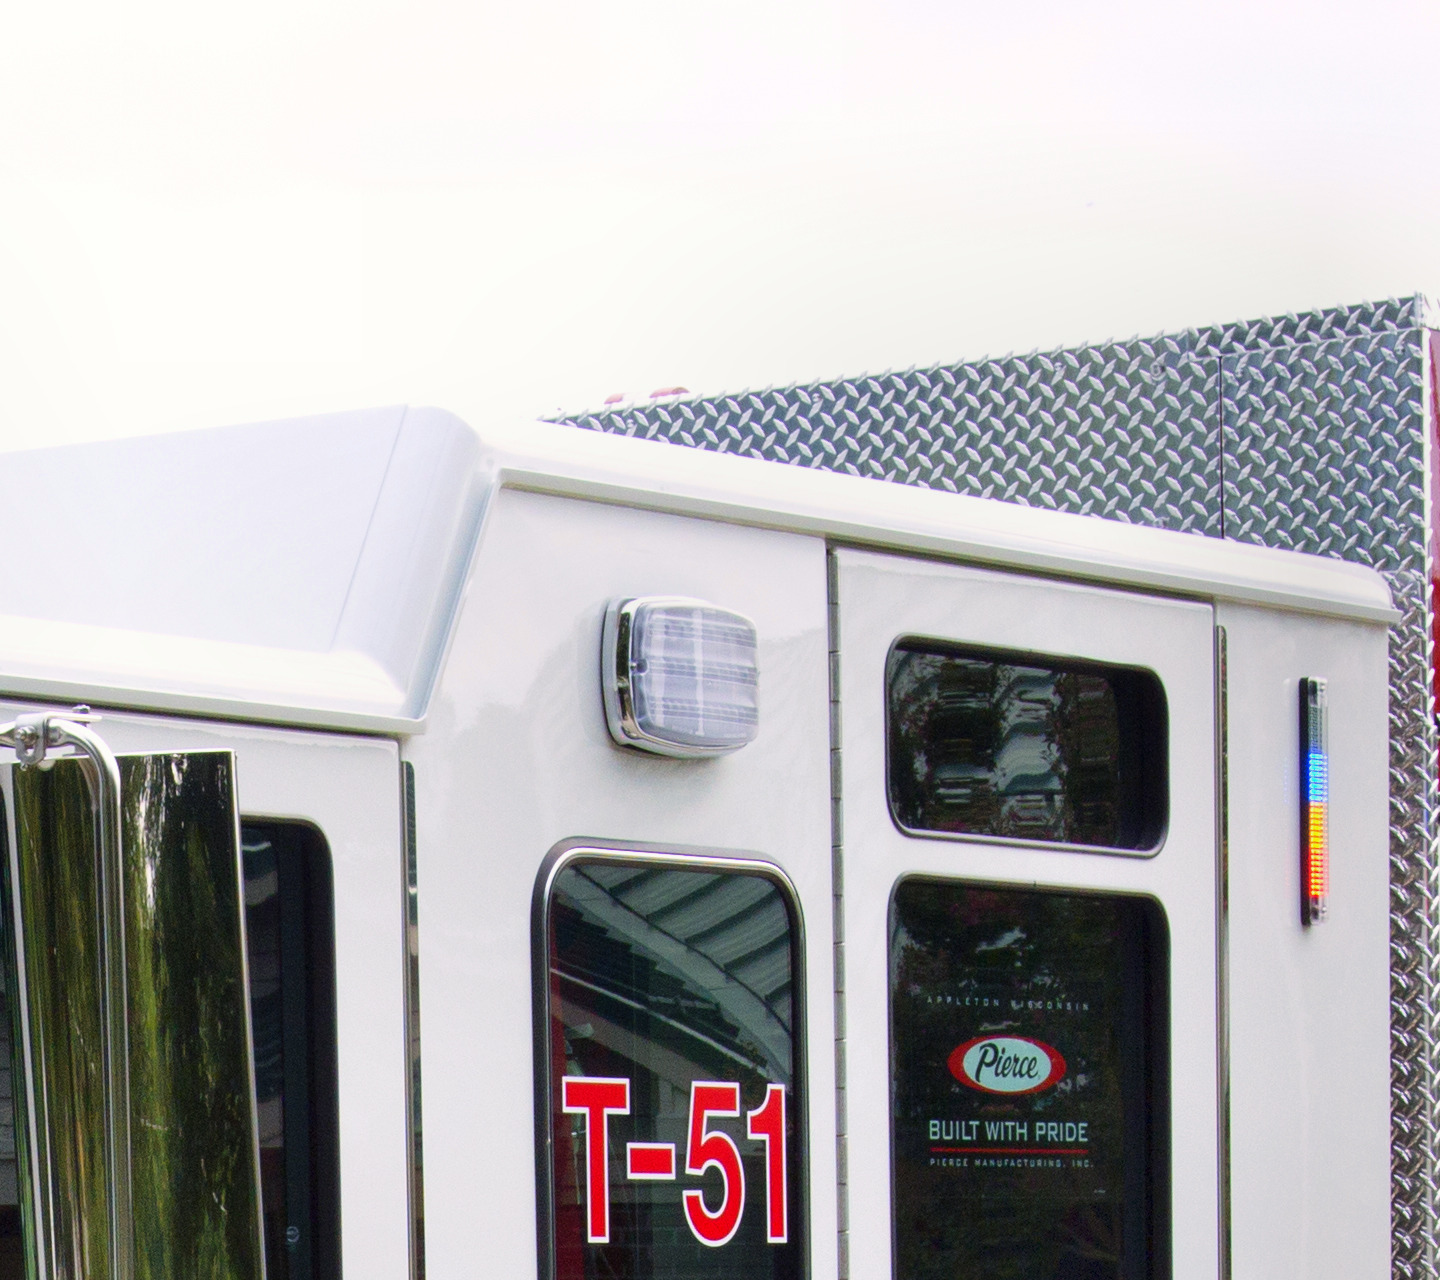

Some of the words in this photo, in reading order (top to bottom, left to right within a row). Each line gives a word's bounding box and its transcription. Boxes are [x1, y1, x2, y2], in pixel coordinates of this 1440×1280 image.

[927, 996, 1000, 1008] APPLETON
[975, 1042, 1039, 1083] Pierce
[929, 1119, 980, 1141] BUILT
[985, 1121, 1028, 1142] WITH
[1035, 1122, 1089, 1142] PRIDE
[561, 1076, 789, 1247] T-51
[929, 1157, 969, 1168] PIERCE
[1071, 1159, 1095, 1169] INC.
